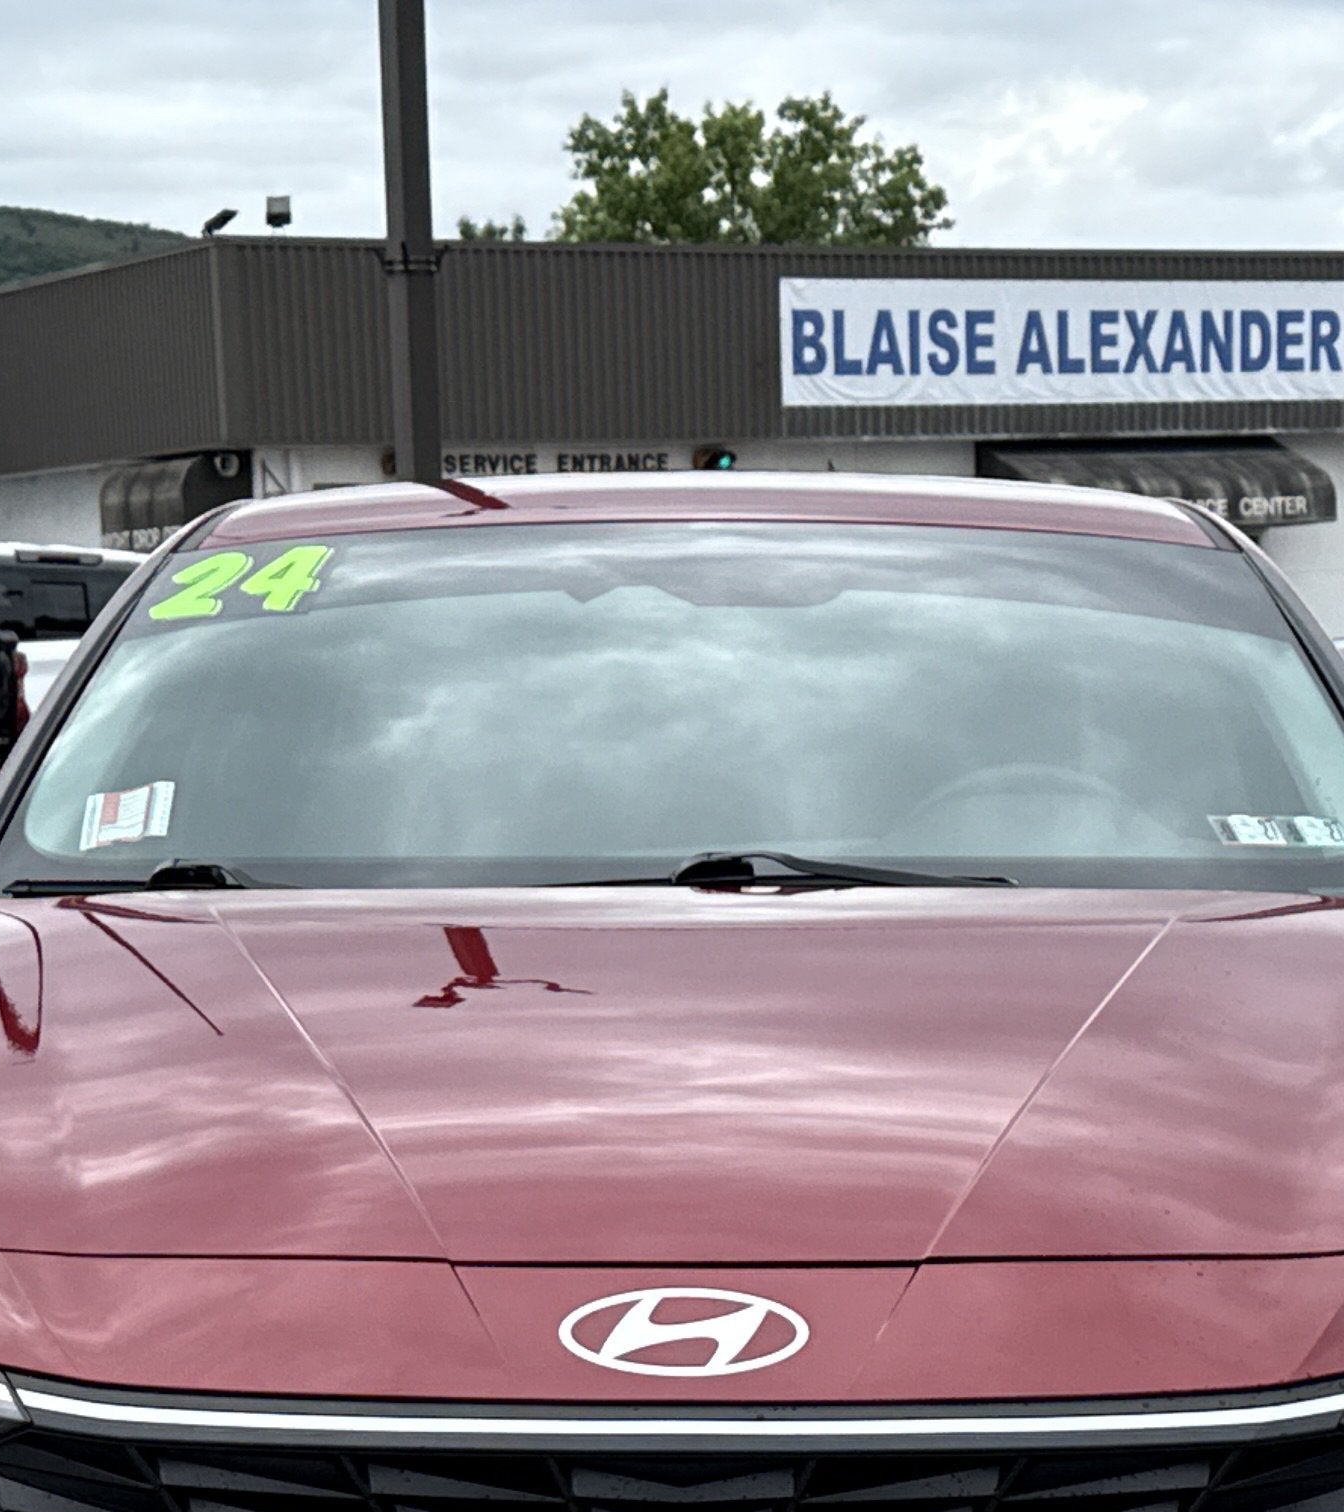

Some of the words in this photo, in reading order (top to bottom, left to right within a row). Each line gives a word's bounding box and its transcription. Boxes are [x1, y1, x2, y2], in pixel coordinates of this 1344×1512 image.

[791, 308, 996, 376] BLAISE
[1016, 309, 1343, 375] ALEXANDER
[442, 453, 539, 474] SERVICE
[557, 452, 670, 473] ENTRANCE
[1239, 496, 1307, 516] CENTER
[149, 545, 335, 620] 24
